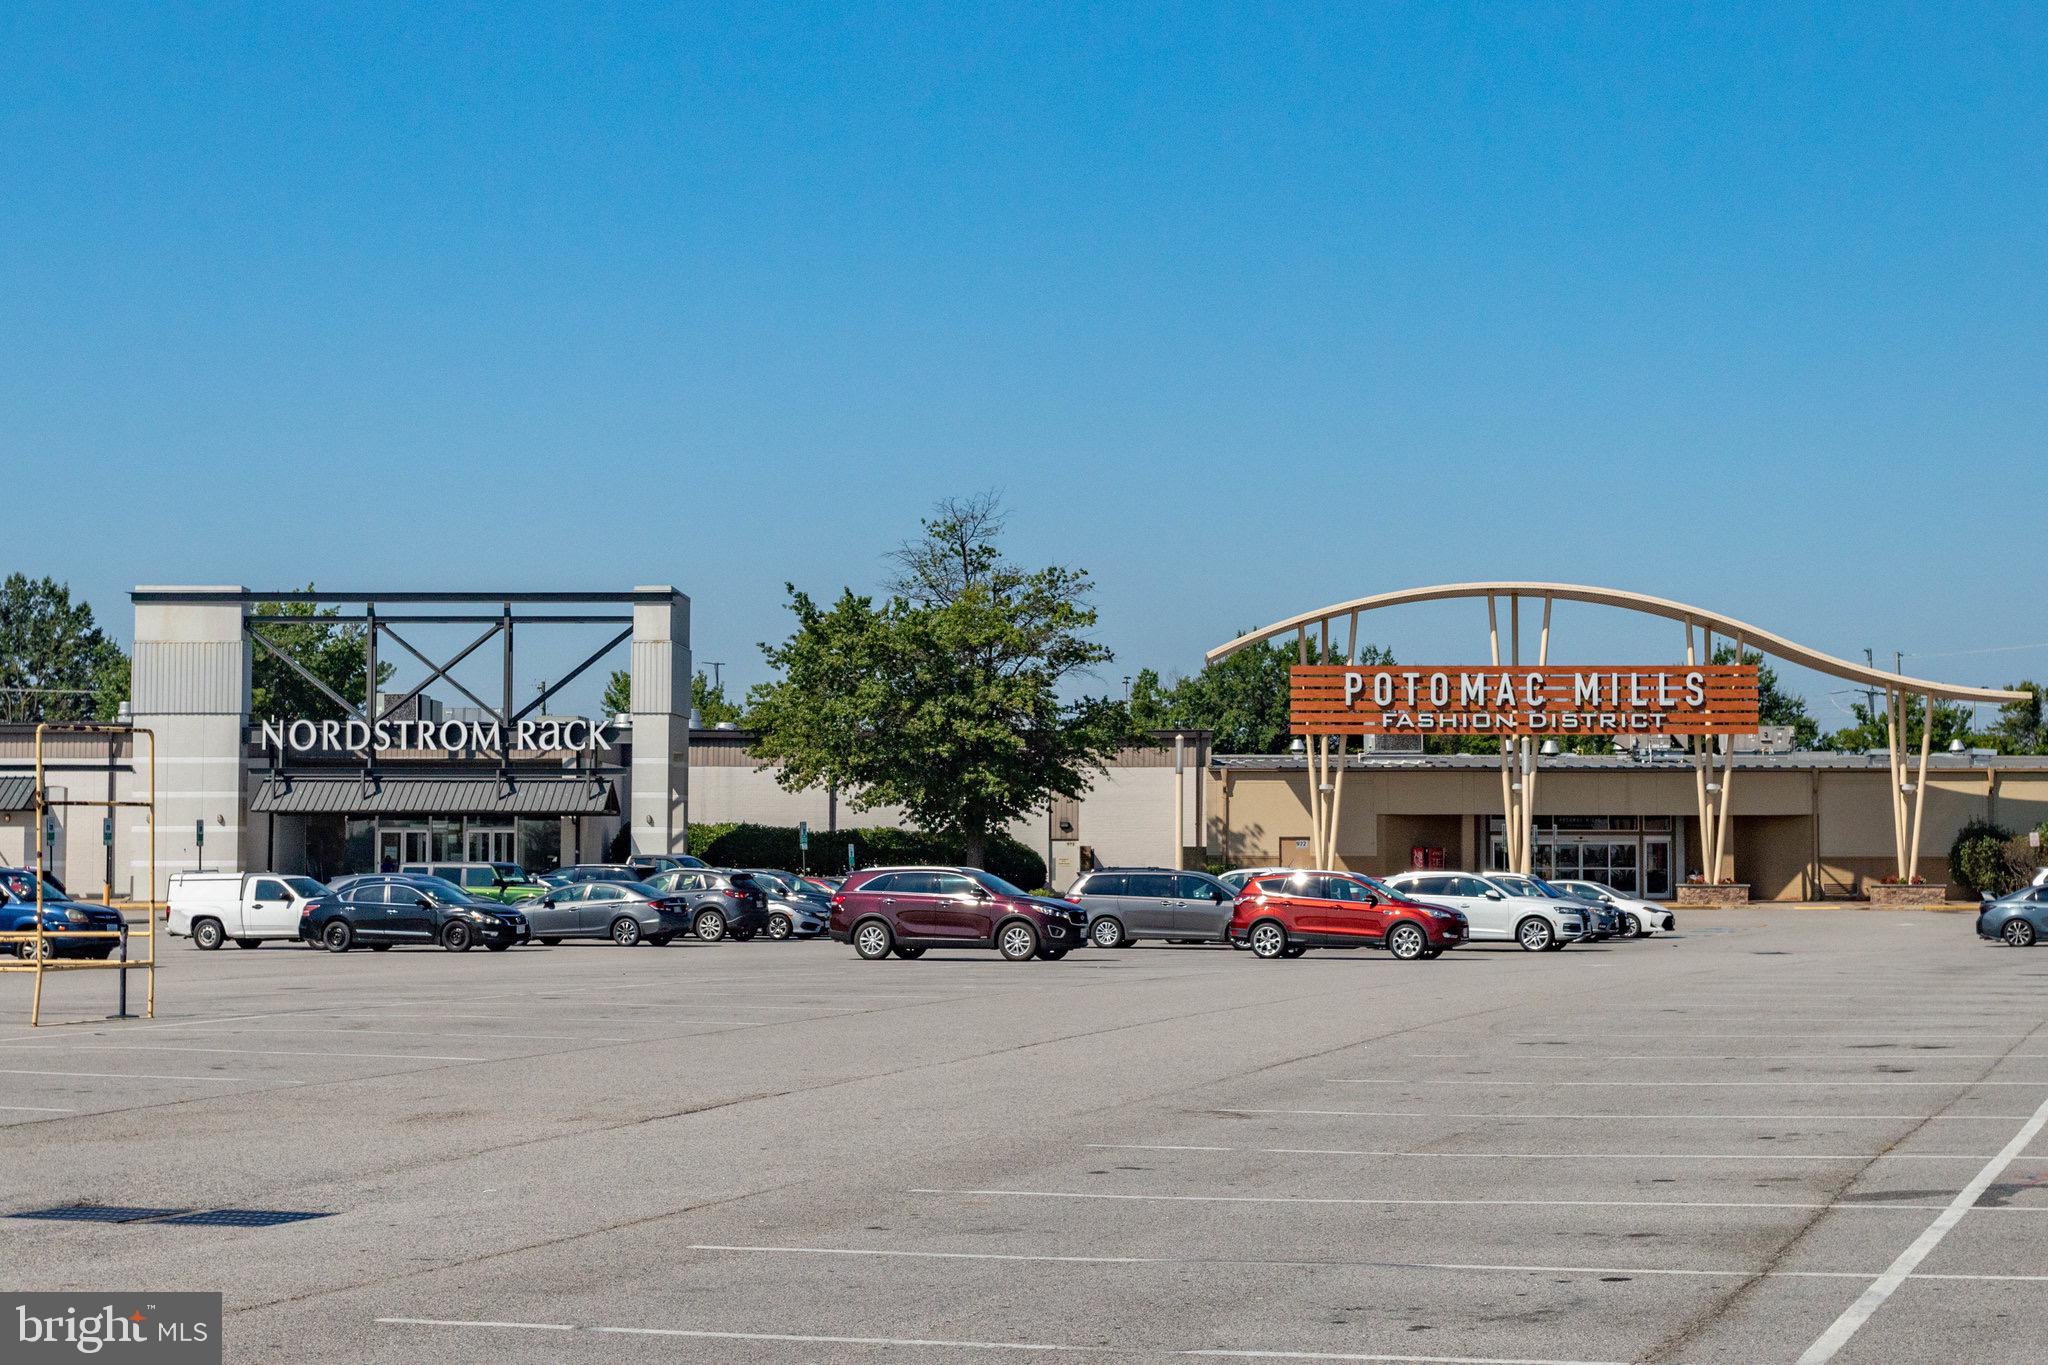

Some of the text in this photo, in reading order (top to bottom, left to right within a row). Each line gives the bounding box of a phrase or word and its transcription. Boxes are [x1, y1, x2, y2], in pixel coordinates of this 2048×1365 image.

[1345, 672, 1704, 706] POTOMAC MILLS
[261, 719, 500, 750] NORDSTROM
[1382, 713, 1666, 728] FASHION DISTRICT
